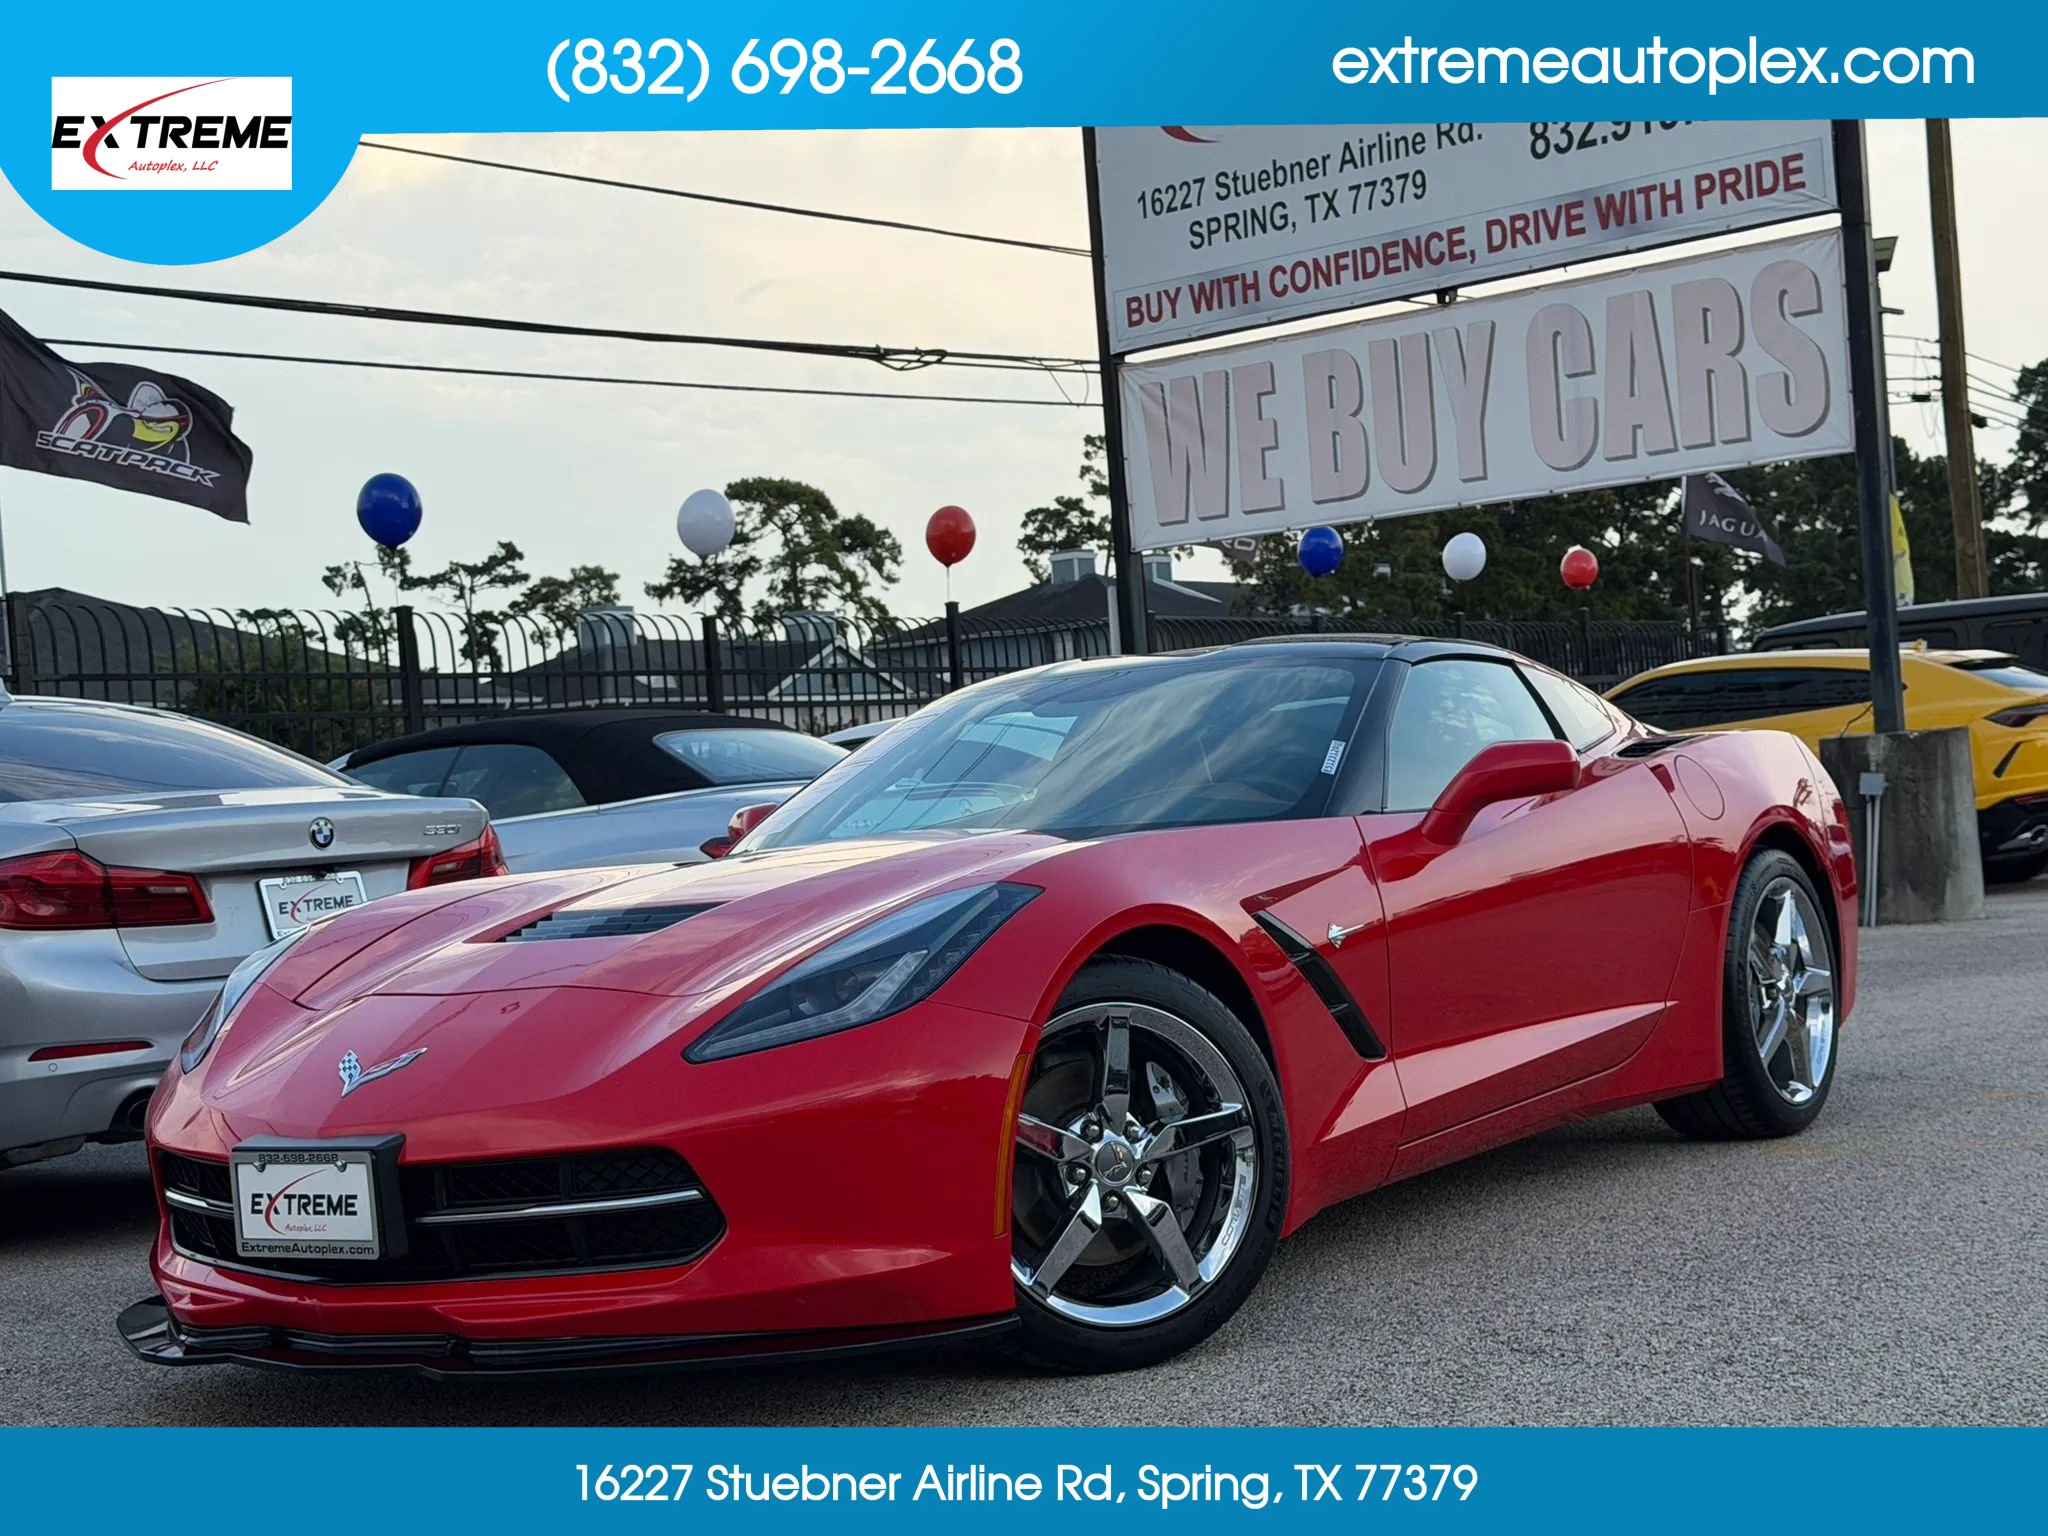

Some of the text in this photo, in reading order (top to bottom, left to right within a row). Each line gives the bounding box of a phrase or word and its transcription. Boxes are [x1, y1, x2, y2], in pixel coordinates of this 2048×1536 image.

[1137, 177, 1206, 219] 16227
[1214, 153, 1332, 202] Stuebner
[1338, 130, 1427, 174] Airline
[1188, 168, 1428, 250] SPRING, TX 77379
[1125, 152, 1807, 329] BUY WITH CONFIDENCE, DRIVE WITH PRIDE
[1140, 258, 1831, 527] WE BUY CARS
[278, 894, 354, 915] EXTREME
[257, 1152, 339, 1164] 832-698-2668
[251, 1193, 358, 1216] EXTREME
[241, 1241, 375, 1256] ExtremeAutoplex.com
